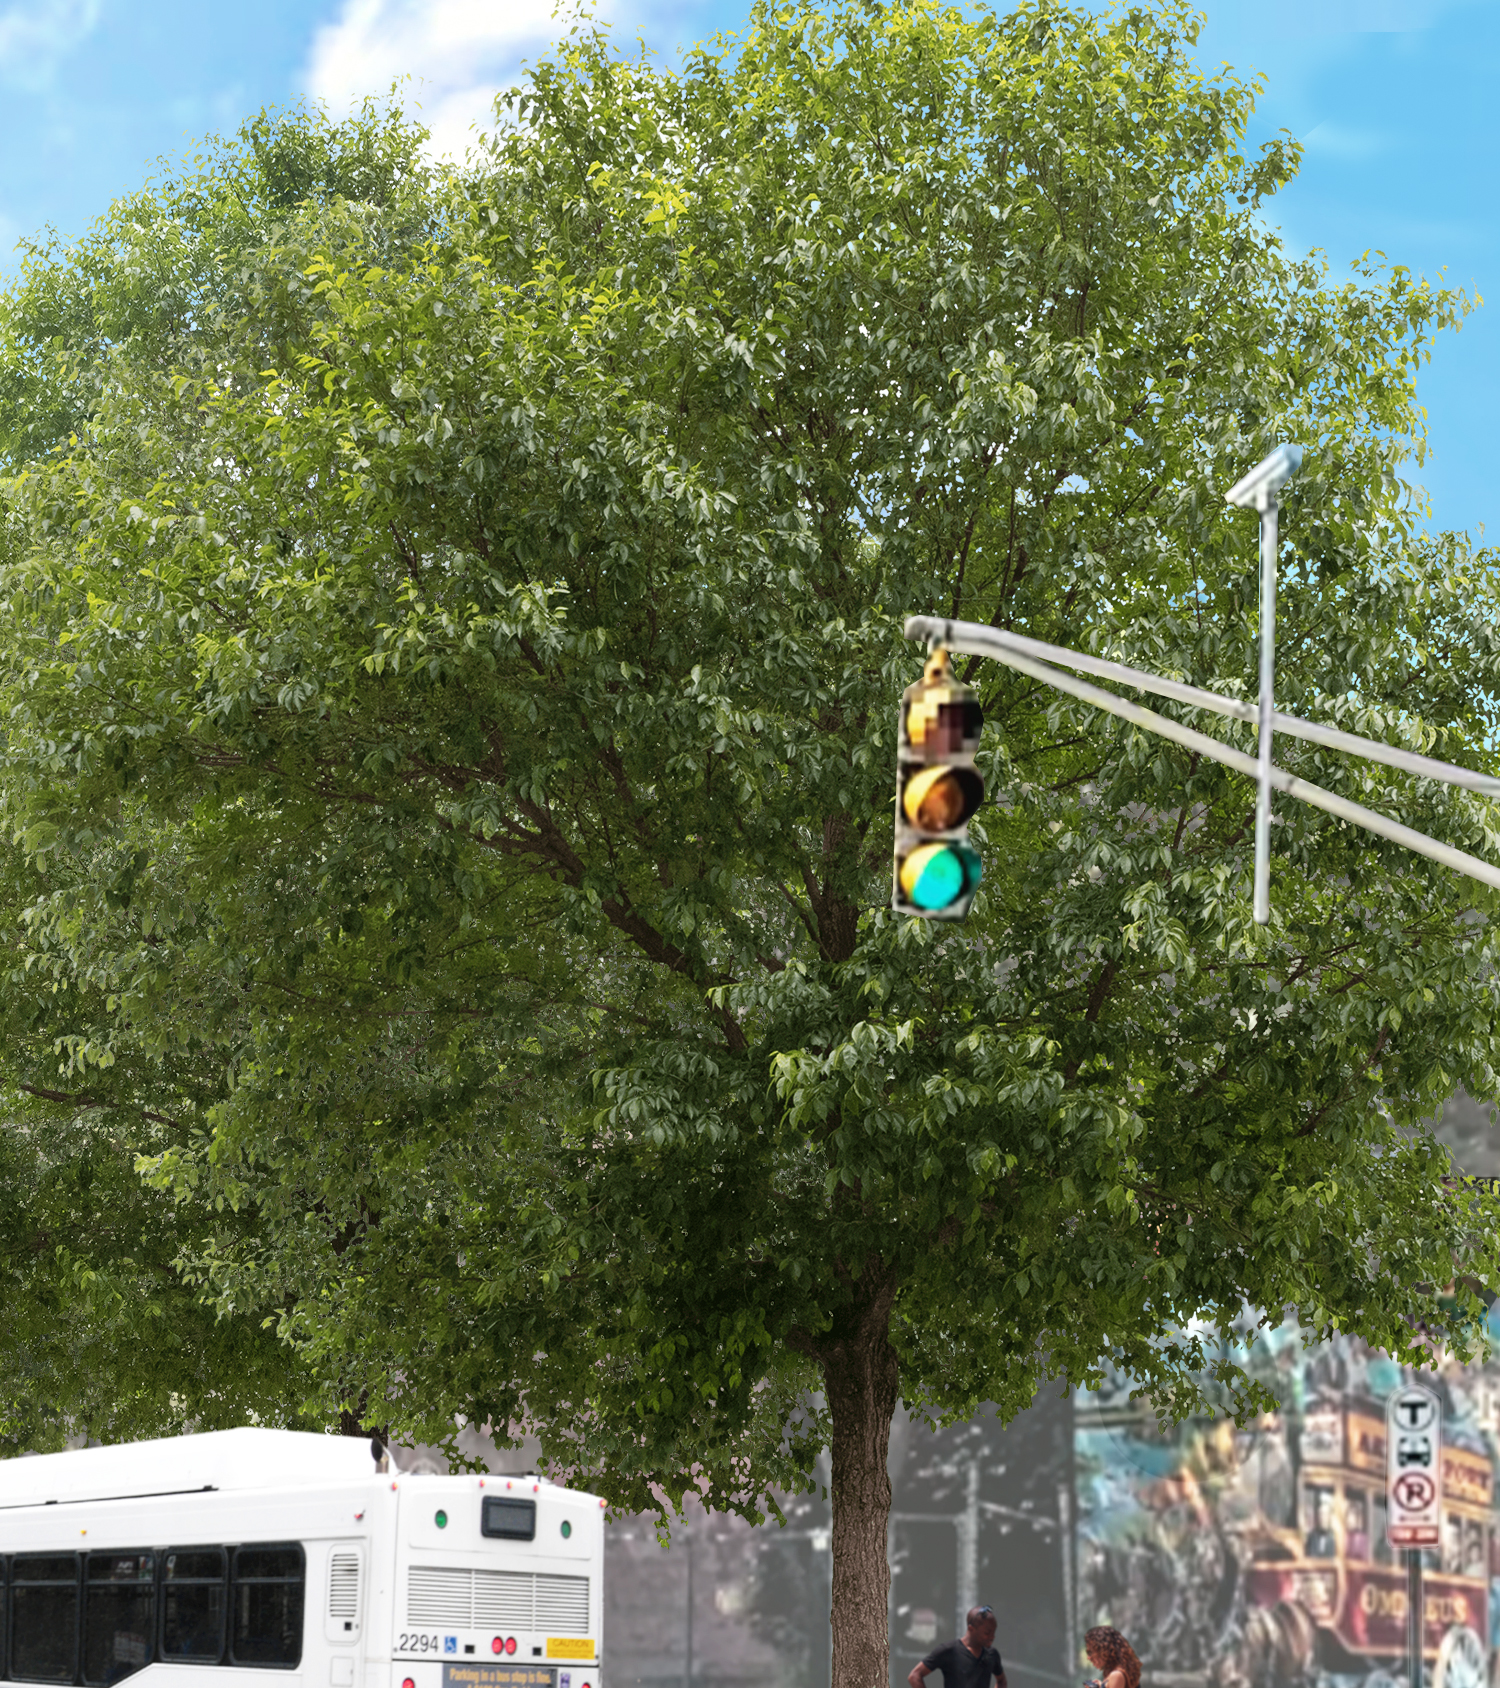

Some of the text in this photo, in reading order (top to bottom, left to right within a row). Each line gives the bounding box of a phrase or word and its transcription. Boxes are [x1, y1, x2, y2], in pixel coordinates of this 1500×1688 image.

[400, 1633, 439, 1652] 2294
[552, 1638, 589, 1648] CAUTION
[450, 1668, 479, 1684] Parking
[481, 1670, 488, 1681] in
